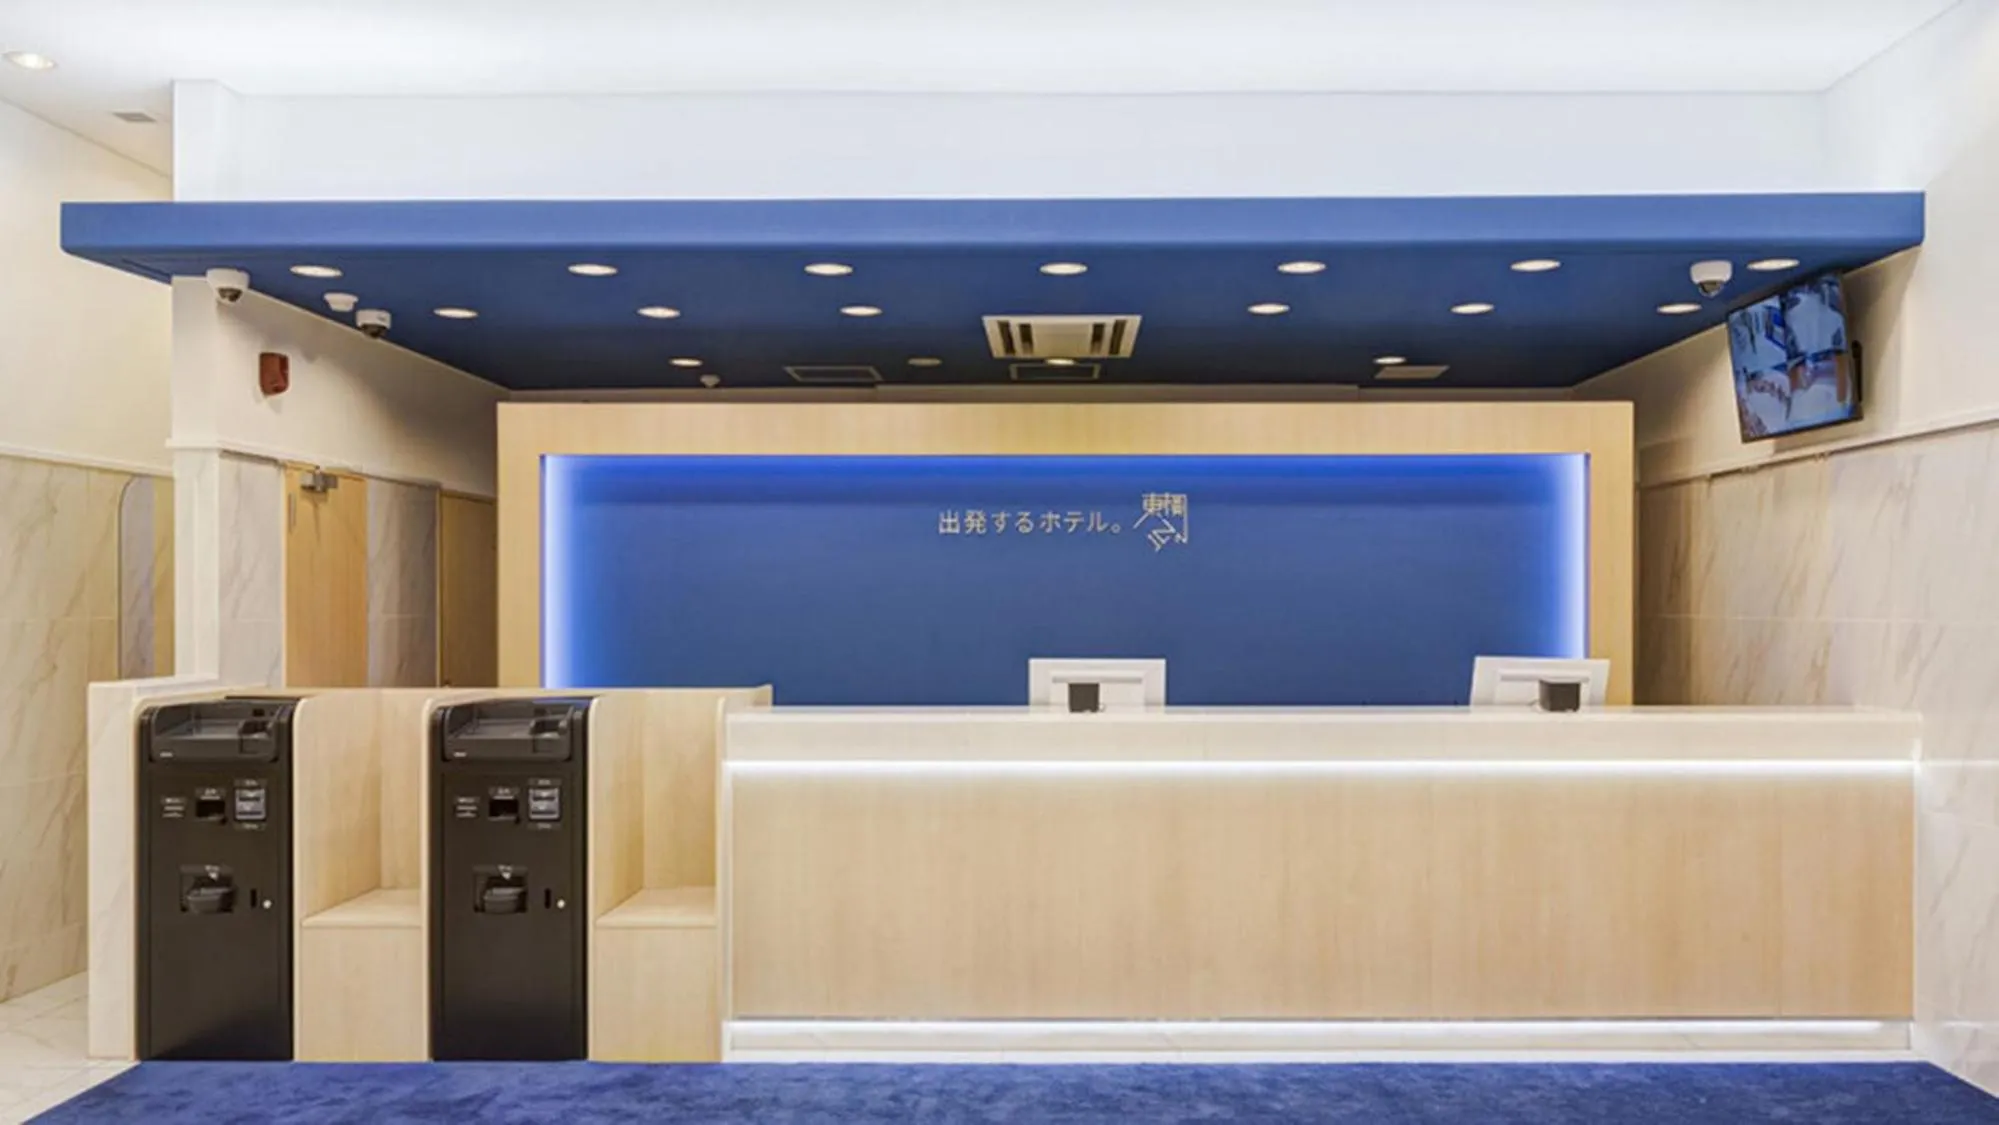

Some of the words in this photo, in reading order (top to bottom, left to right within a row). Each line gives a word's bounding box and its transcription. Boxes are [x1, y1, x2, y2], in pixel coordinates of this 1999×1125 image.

[938, 509, 1121, 534] 出発するホテル。
